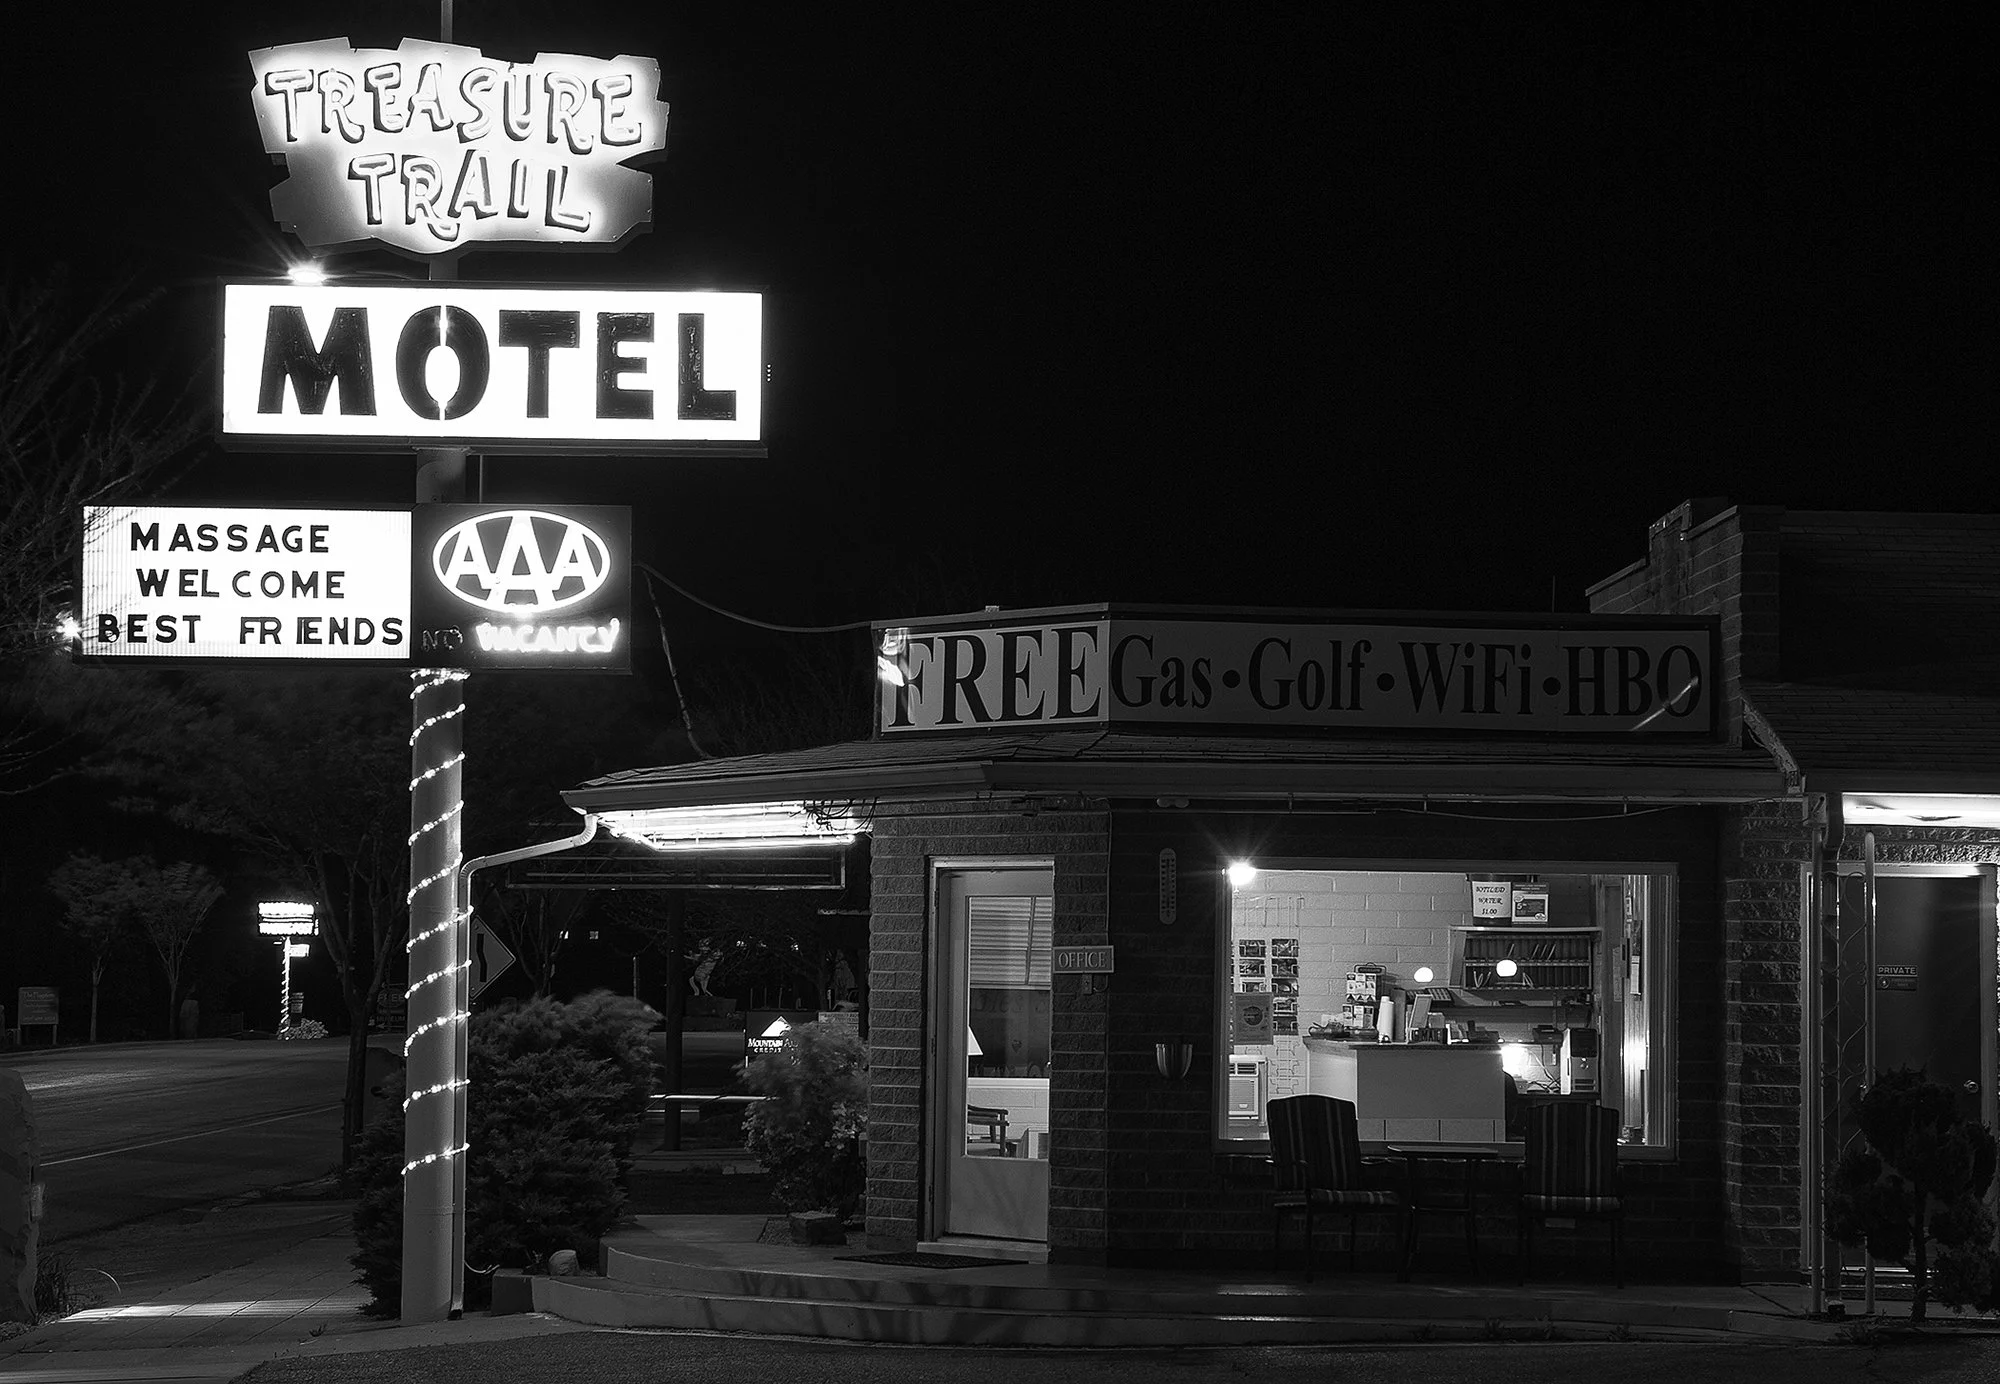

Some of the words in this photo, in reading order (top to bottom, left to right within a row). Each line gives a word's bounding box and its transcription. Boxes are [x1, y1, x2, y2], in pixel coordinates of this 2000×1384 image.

[265, 62, 643, 155] TREASURE
[348, 149, 592, 241] TRAIL
[257, 304, 738, 421] MOTEL
[131, 522, 330, 554] MASSAGE
[442, 515, 602, 607] AAA
[98, 613, 202, 645] BEST
[422, 625, 464, 651] NO
[474, 617, 619, 653] VACANCY
[884, 624, 1104, 728] FREE
[1110, 634, 1213, 709] Gas
[1248, 638, 1372, 713] Golf
[1397, 641, 1535, 716] WiFi
[1563, 645, 1703, 718] HBO
[1058, 951, 1106, 968] OFFICE
[1878, 966, 1916, 975] PRIVATE
